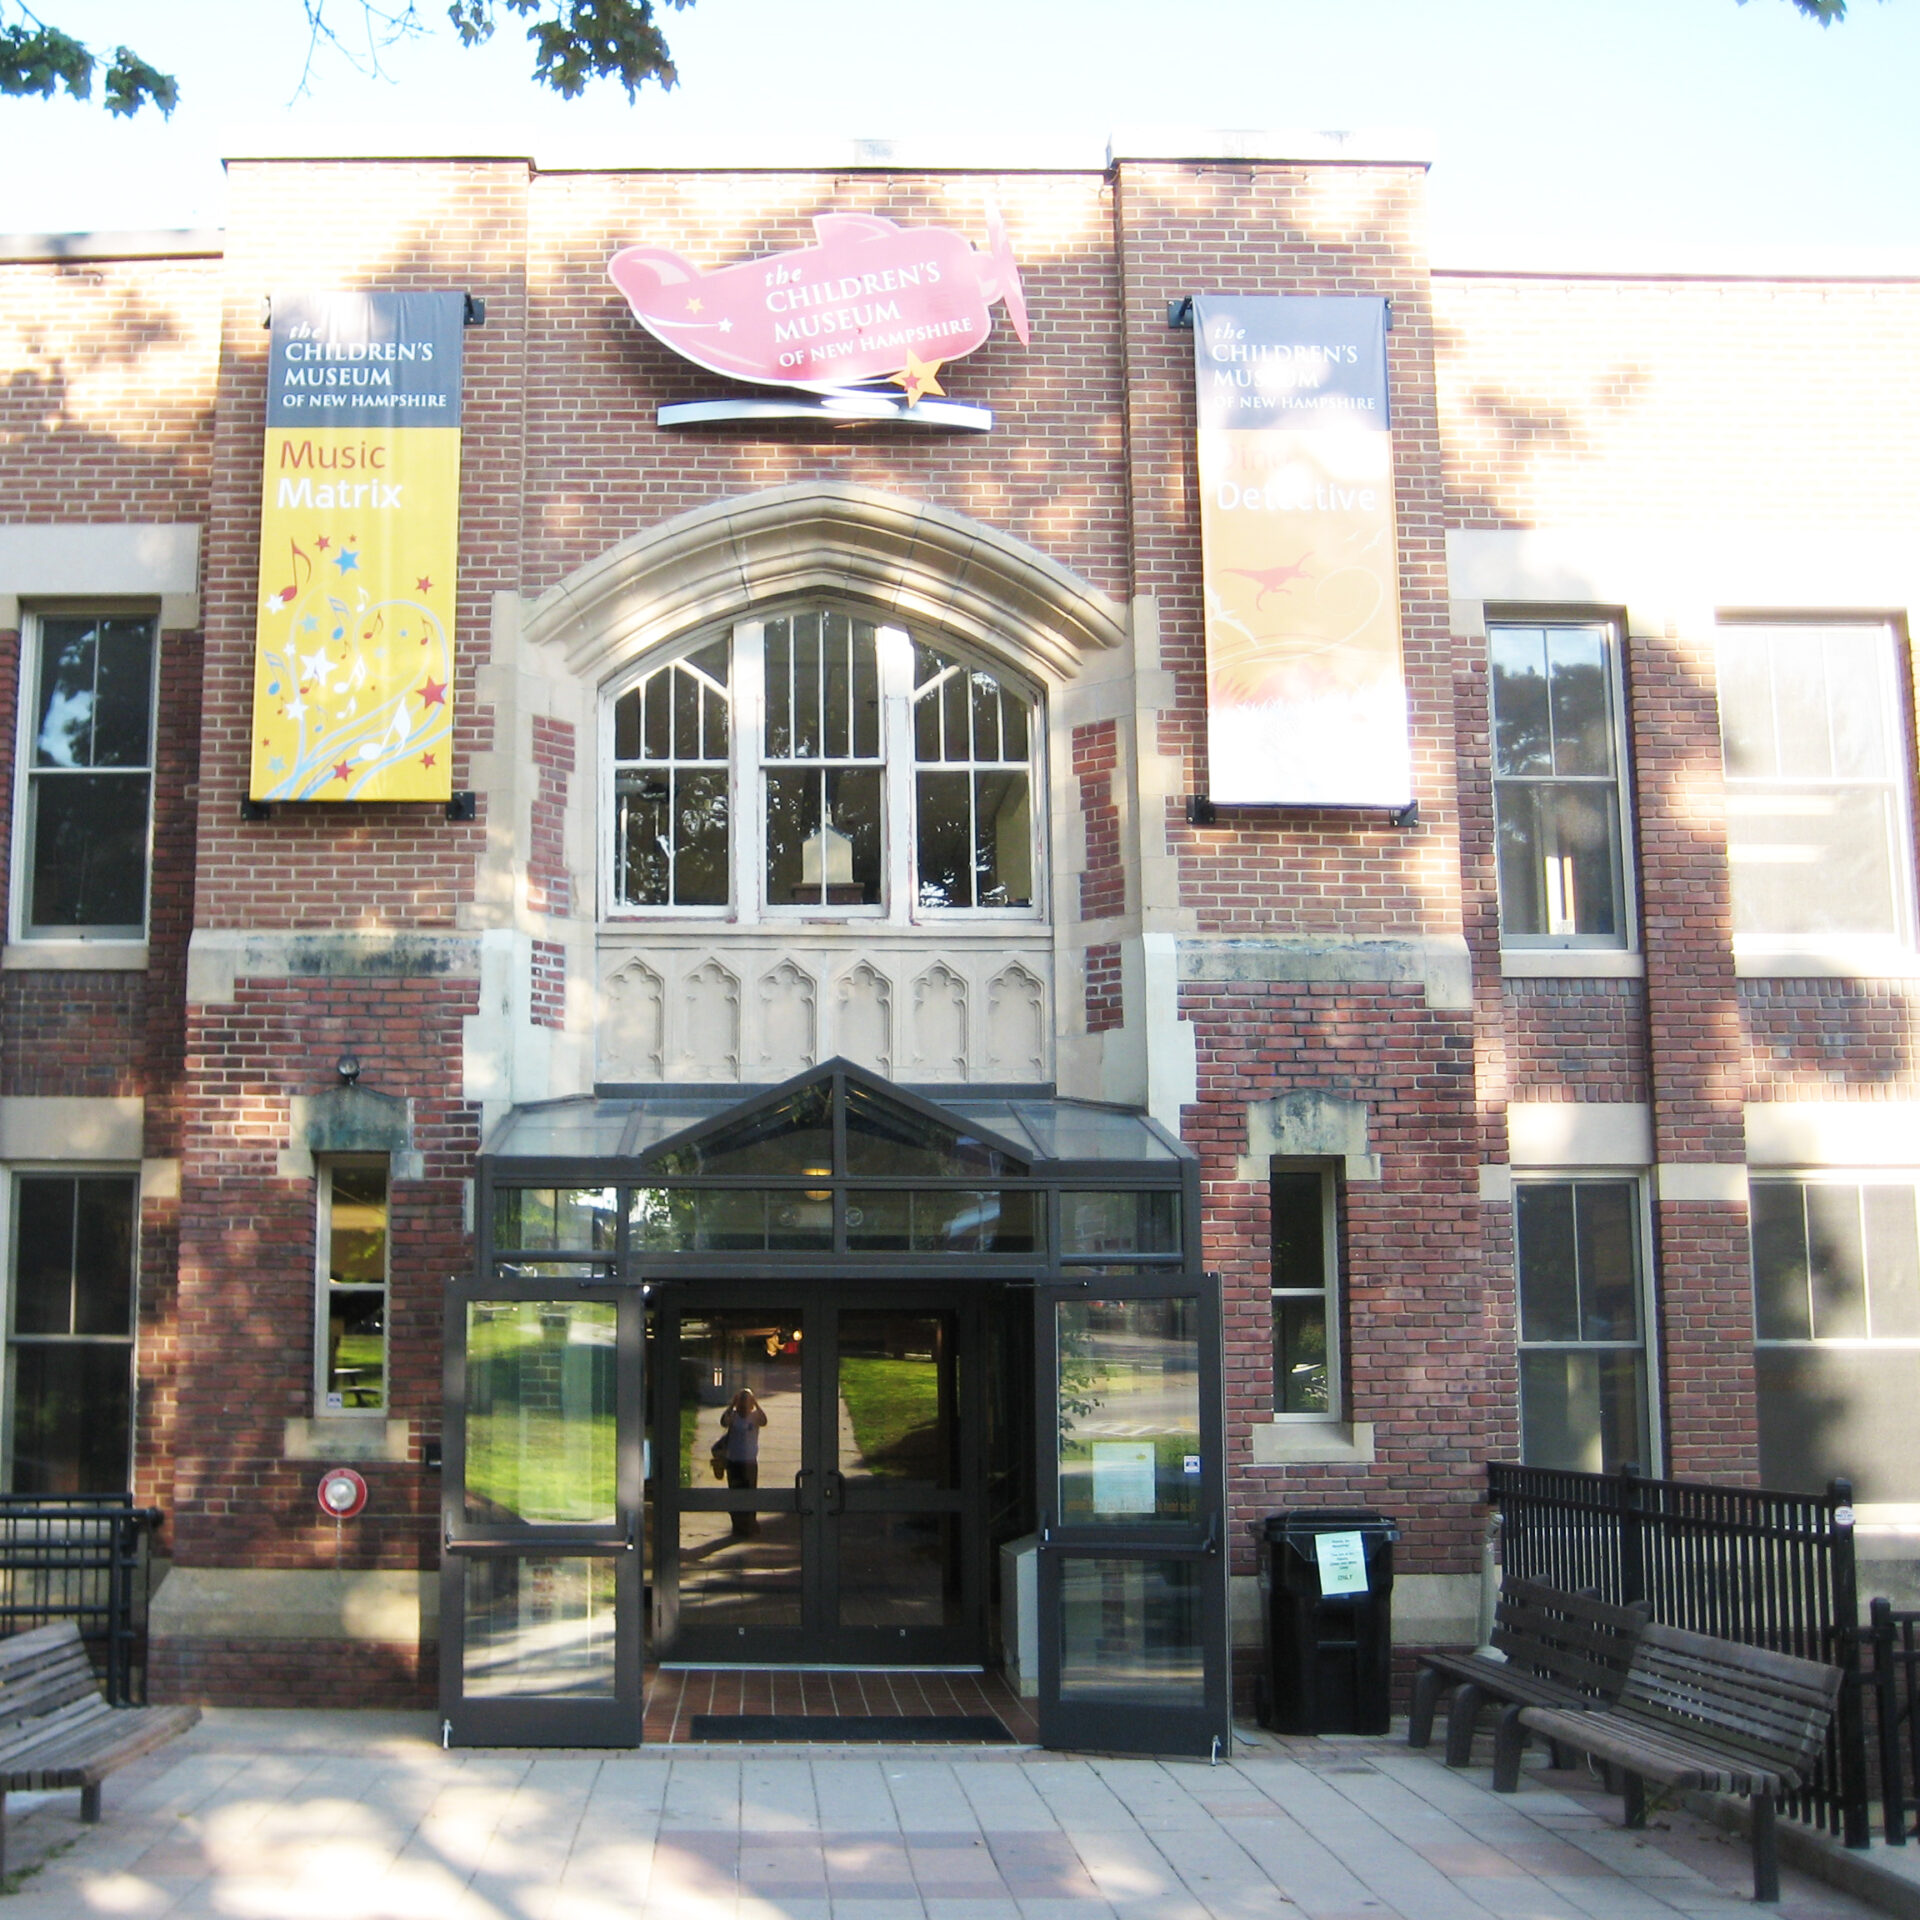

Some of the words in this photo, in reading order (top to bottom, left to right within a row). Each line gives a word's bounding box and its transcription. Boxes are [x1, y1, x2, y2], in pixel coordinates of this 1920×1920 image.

[764, 263, 802, 289] the
[765, 260, 941, 313] CHILDREN'S
[288, 321, 322, 340] the
[773, 300, 902, 343] MUSEUM
[1214, 321, 1247, 340] the
[284, 342, 434, 362] CHILDREN'S
[778, 349, 806, 368] OF
[810, 341, 856, 362] NEW
[860, 317, 973, 353] HAMPSHIRE
[1211, 343, 1358, 364] CHILDREN'S
[283, 367, 393, 387] MUSEUM
[1213, 368, 1321, 389] MUSUM
[282, 394, 306, 408] OF
[309, 394, 348, 408] NEW
[350, 394, 447, 408] HAMPSHIRE
[1214, 395, 1235, 409] OF
[1239, 396, 1276, 409] NEW
[1281, 396, 1376, 410] HAMPSHIRE
[279, 440, 387, 470] Music
[277, 477, 404, 510] Matrix
[1216, 480, 1376, 512] Dettive
